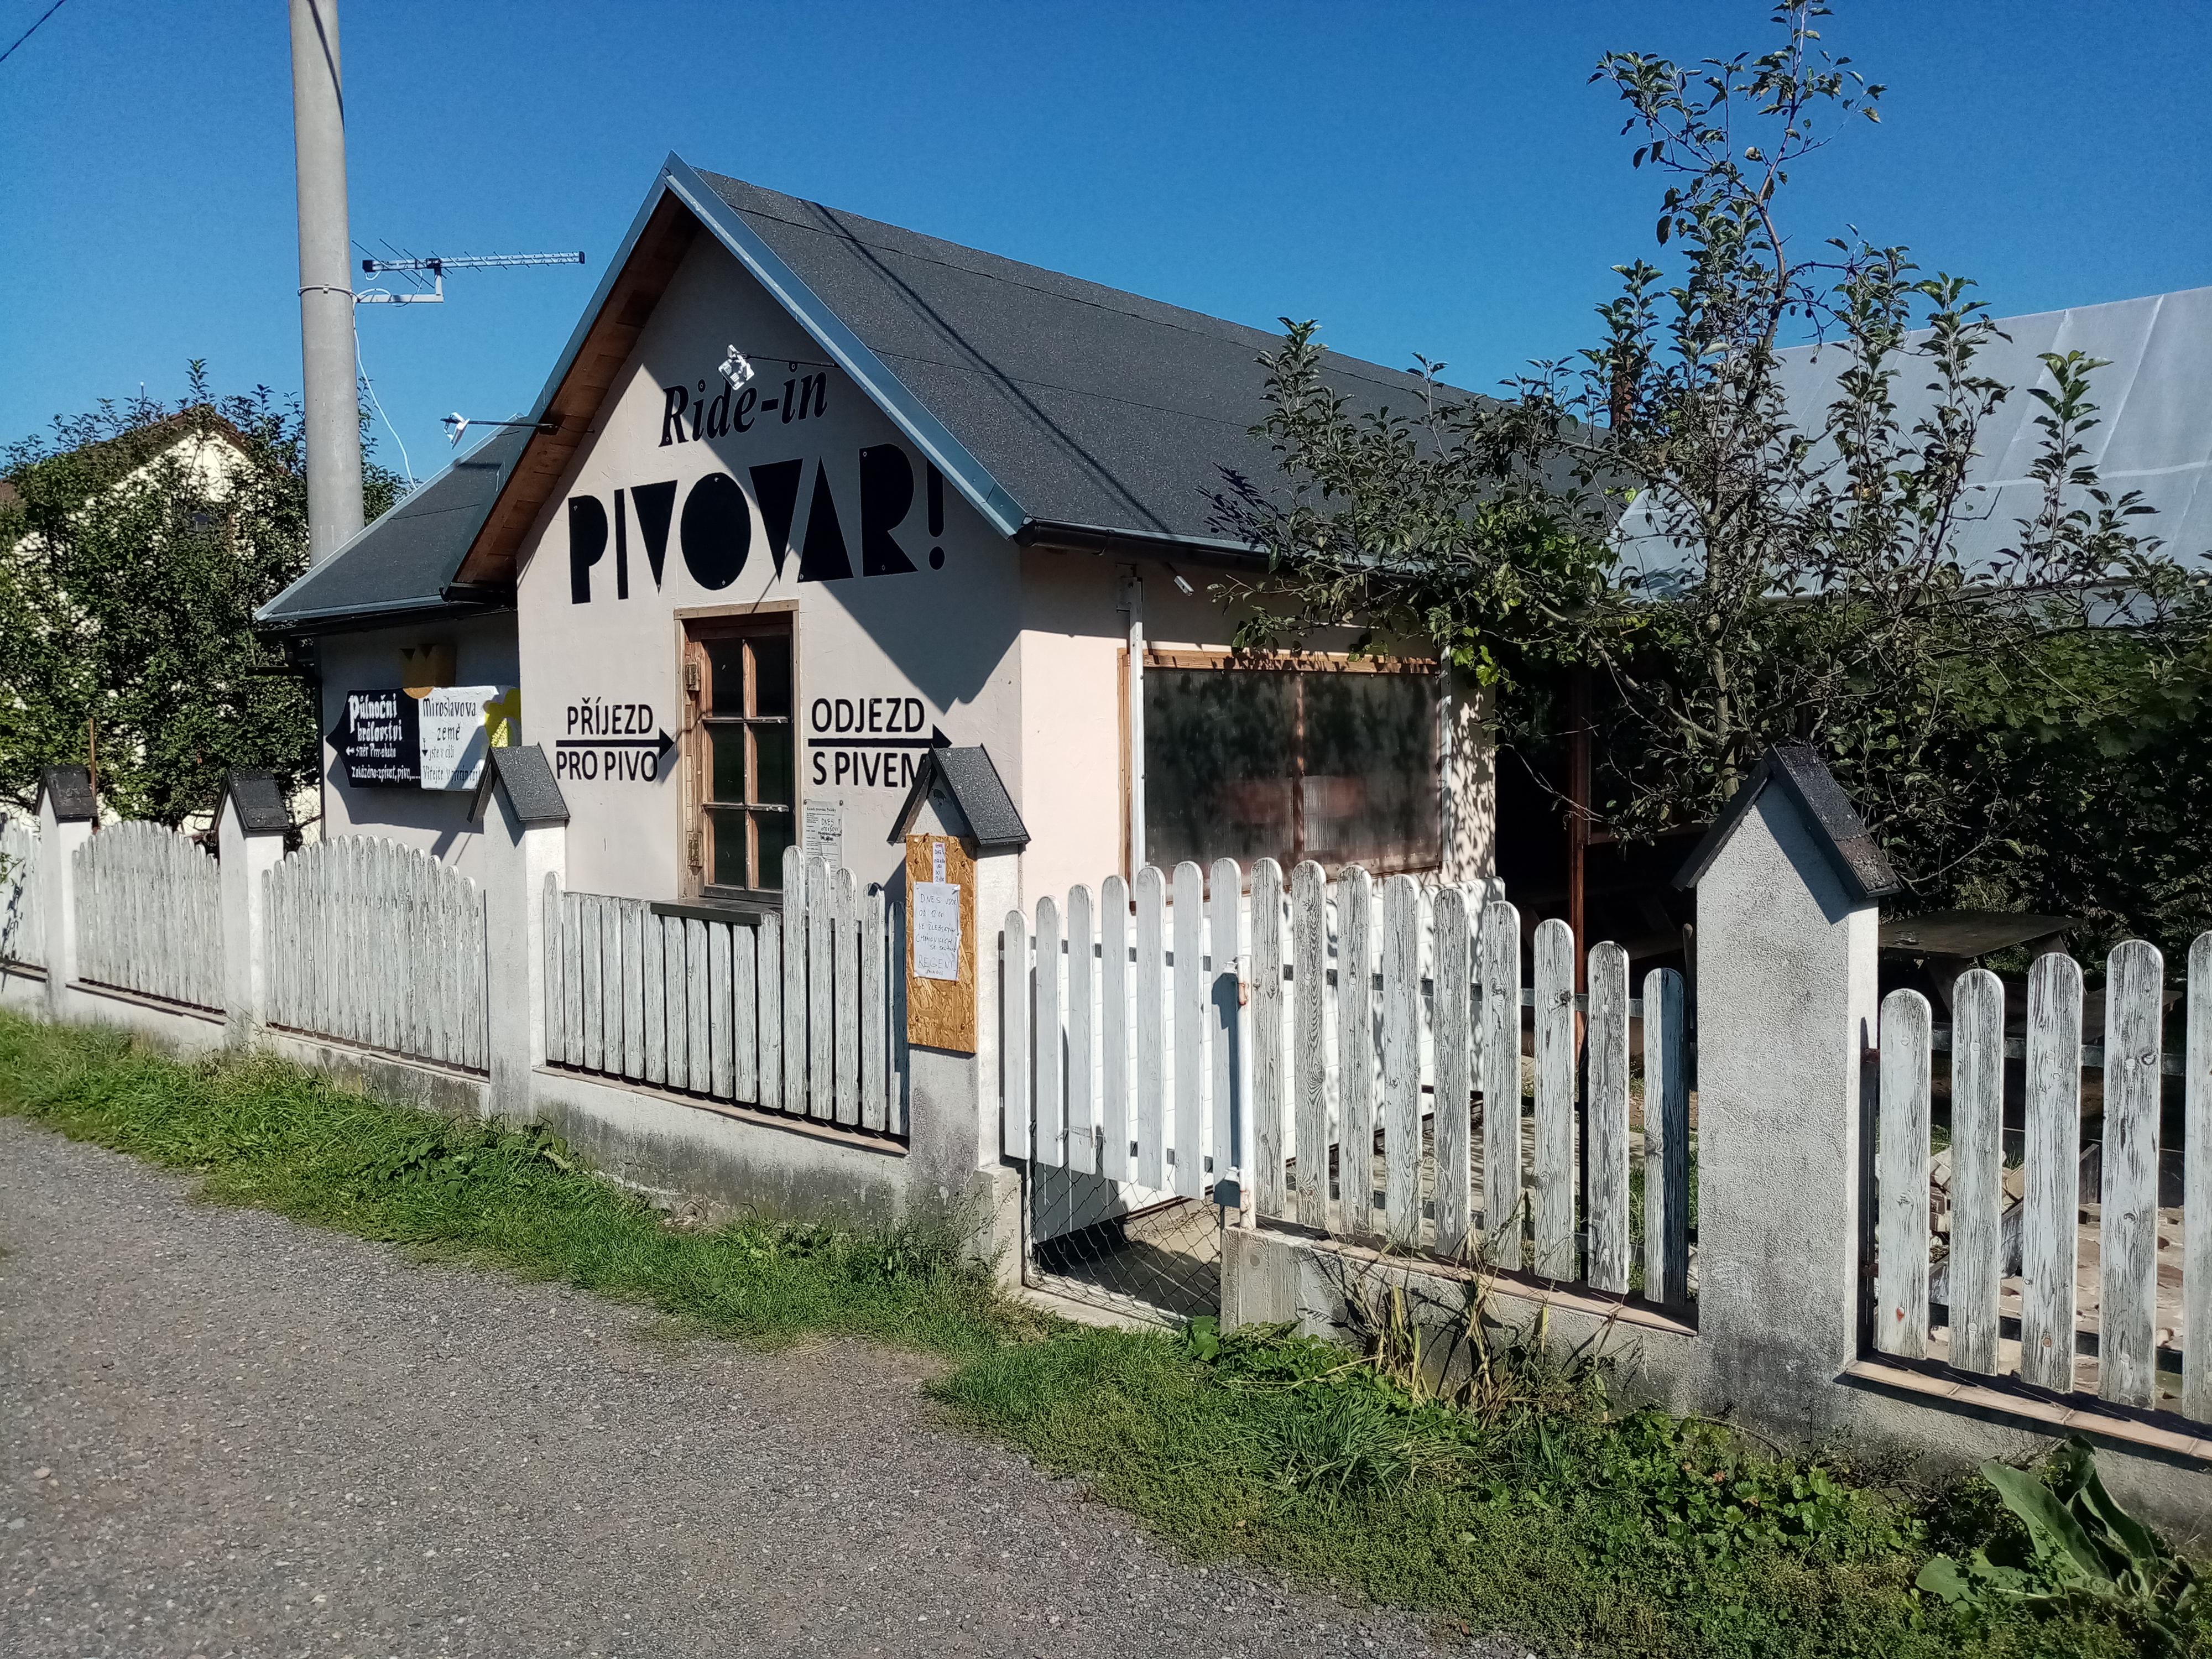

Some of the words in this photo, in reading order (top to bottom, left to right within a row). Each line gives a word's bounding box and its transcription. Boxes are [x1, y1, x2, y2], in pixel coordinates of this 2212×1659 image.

[658, 362, 828, 447] Ride-in
[568, 443, 945, 604] PIVOVAR!
[348, 693, 397, 734] Půlnoční
[423, 697, 476, 717] Miroslavova
[567, 696, 653, 735] PŘÍJEZD
[812, 698, 925, 733] ODJEZD
[357, 719, 403, 742] království
[437, 721, 461, 741] země
[429, 746, 439, 761] jste
[440, 748, 444, 758] v
[556, 750, 598, 780] PRO
[604, 750, 658, 781] PIVO
[813, 752, 827, 785] S
[921, 893, 941, 904] DNES
[918, 954, 954, 969] REGENT
